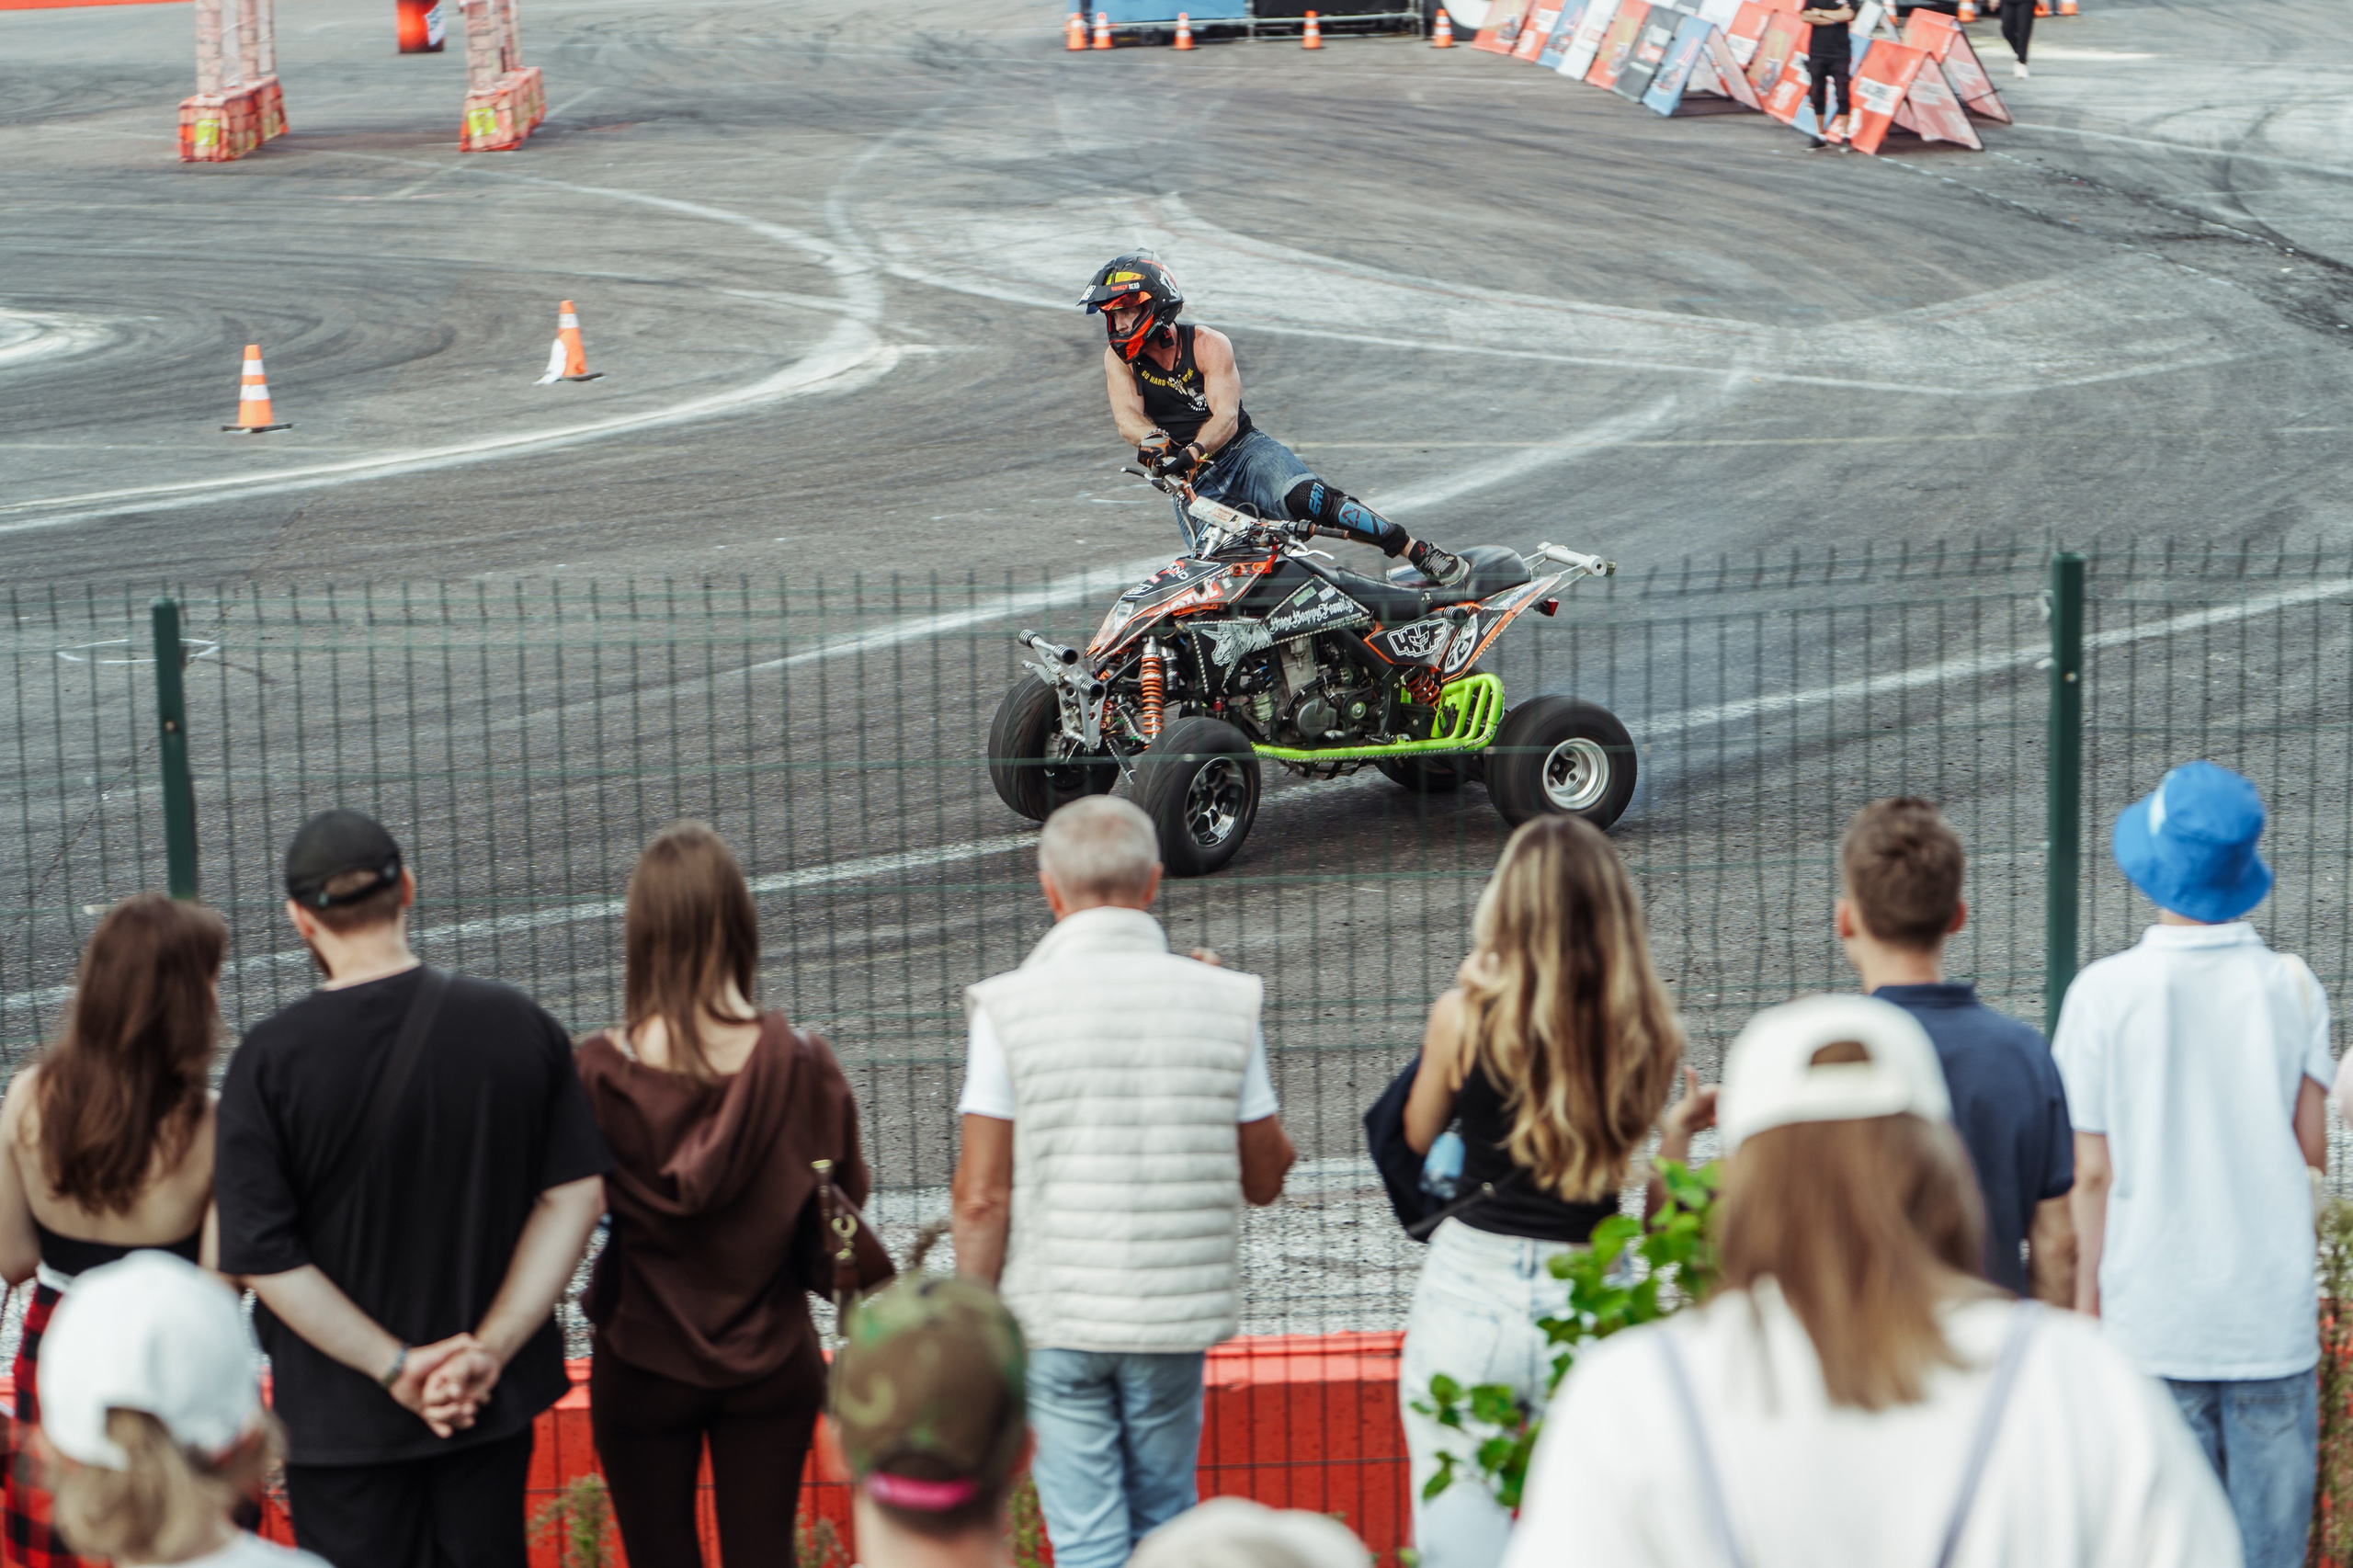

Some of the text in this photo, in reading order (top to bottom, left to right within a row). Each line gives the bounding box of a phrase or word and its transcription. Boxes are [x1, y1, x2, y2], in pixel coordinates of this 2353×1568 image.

[1141, 369, 1151, 381] GO
[1149, 376, 1166, 386] HARD
[1290, 608, 1321, 629] Happy
[1317, 596, 1355, 621] Family
